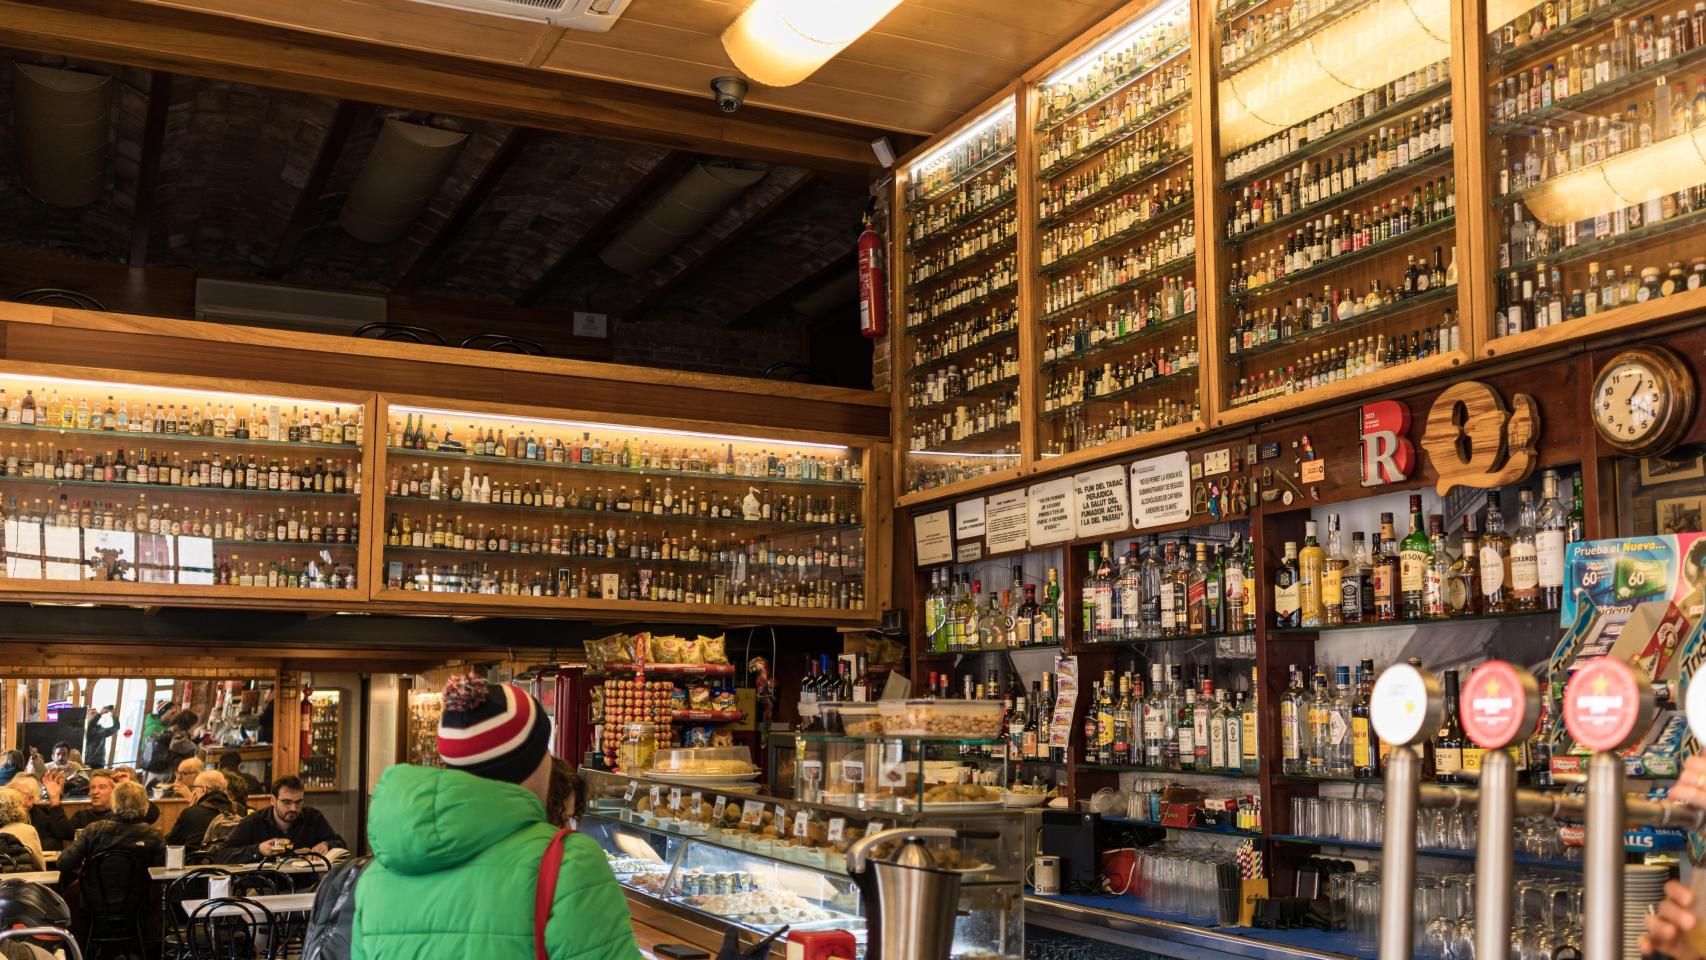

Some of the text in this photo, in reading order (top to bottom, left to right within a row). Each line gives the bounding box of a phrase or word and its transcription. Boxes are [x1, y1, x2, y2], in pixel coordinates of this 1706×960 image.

[1612, 376, 1620, 384] 11
[1648, 380, 1654, 388] 2
[1605, 387, 1613, 396] 10
[1652, 393, 1659, 402] 3
[1603, 401, 1610, 410] 9
[1608, 415, 1614, 424] 8
[1616, 424, 1623, 432] 7
[1641, 420, 1648, 429] 5
[1628, 426, 1635, 434] 6
[1084, 485, 1094, 493] FUM
[1106, 479, 1123, 488] TABAC
[1086, 490, 1113, 500] PERJUDICA
[1091, 499, 1106, 507] SALUT
[1081, 505, 1122, 518] FUMADOR ACTIU
[1574, 542, 1666, 557] Prueba el Nuevo...
[1582, 572, 1598, 586] 60
[1628, 572, 1645, 586] 60
